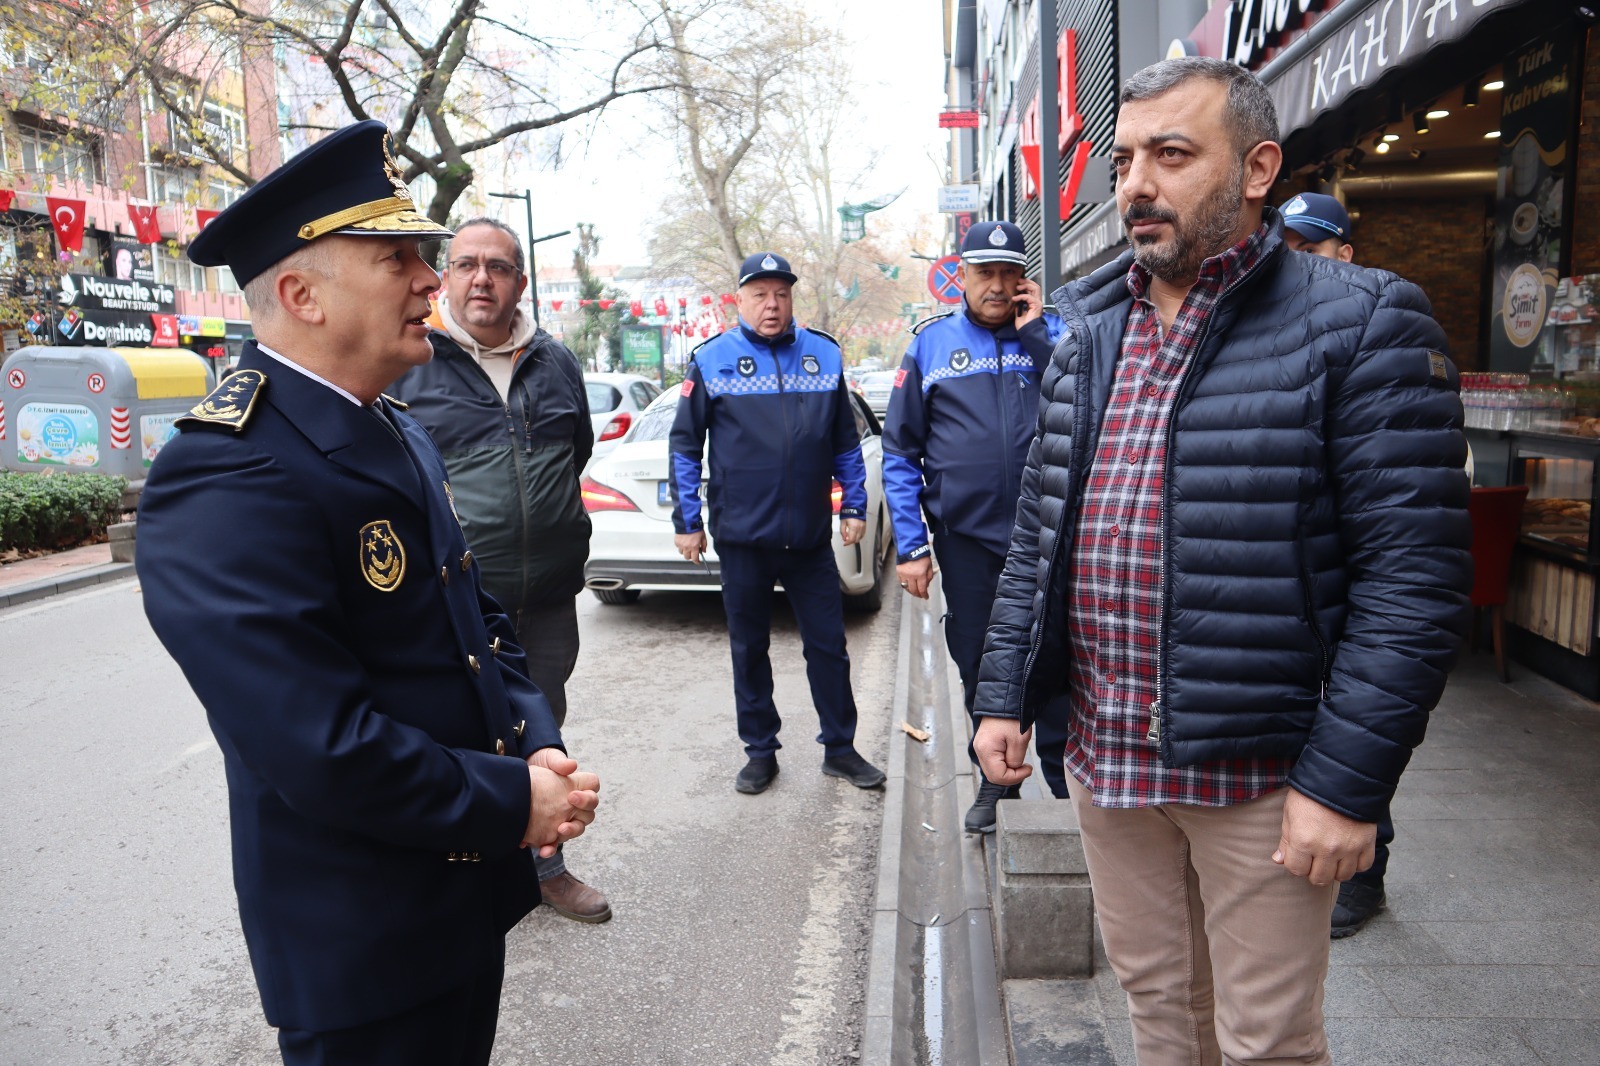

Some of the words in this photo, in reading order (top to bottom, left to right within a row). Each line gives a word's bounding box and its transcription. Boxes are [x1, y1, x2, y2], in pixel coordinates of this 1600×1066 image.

[1311, 0, 1490, 109] KAHVA
[1518, 41, 1554, 77] Türk
[1502, 64, 1568, 117] Kahvesi
[82, 276, 150, 301] Nouvelle
[152, 285, 174, 304] vie
[103, 298, 132, 309] BEAUTY
[133, 301, 159, 312] STUDIO
[1509, 293, 1538, 318] Simit
[83, 320, 151, 342] Domino's
[207, 347, 225, 357] SGK
[910, 545, 930, 559] ZABIT
